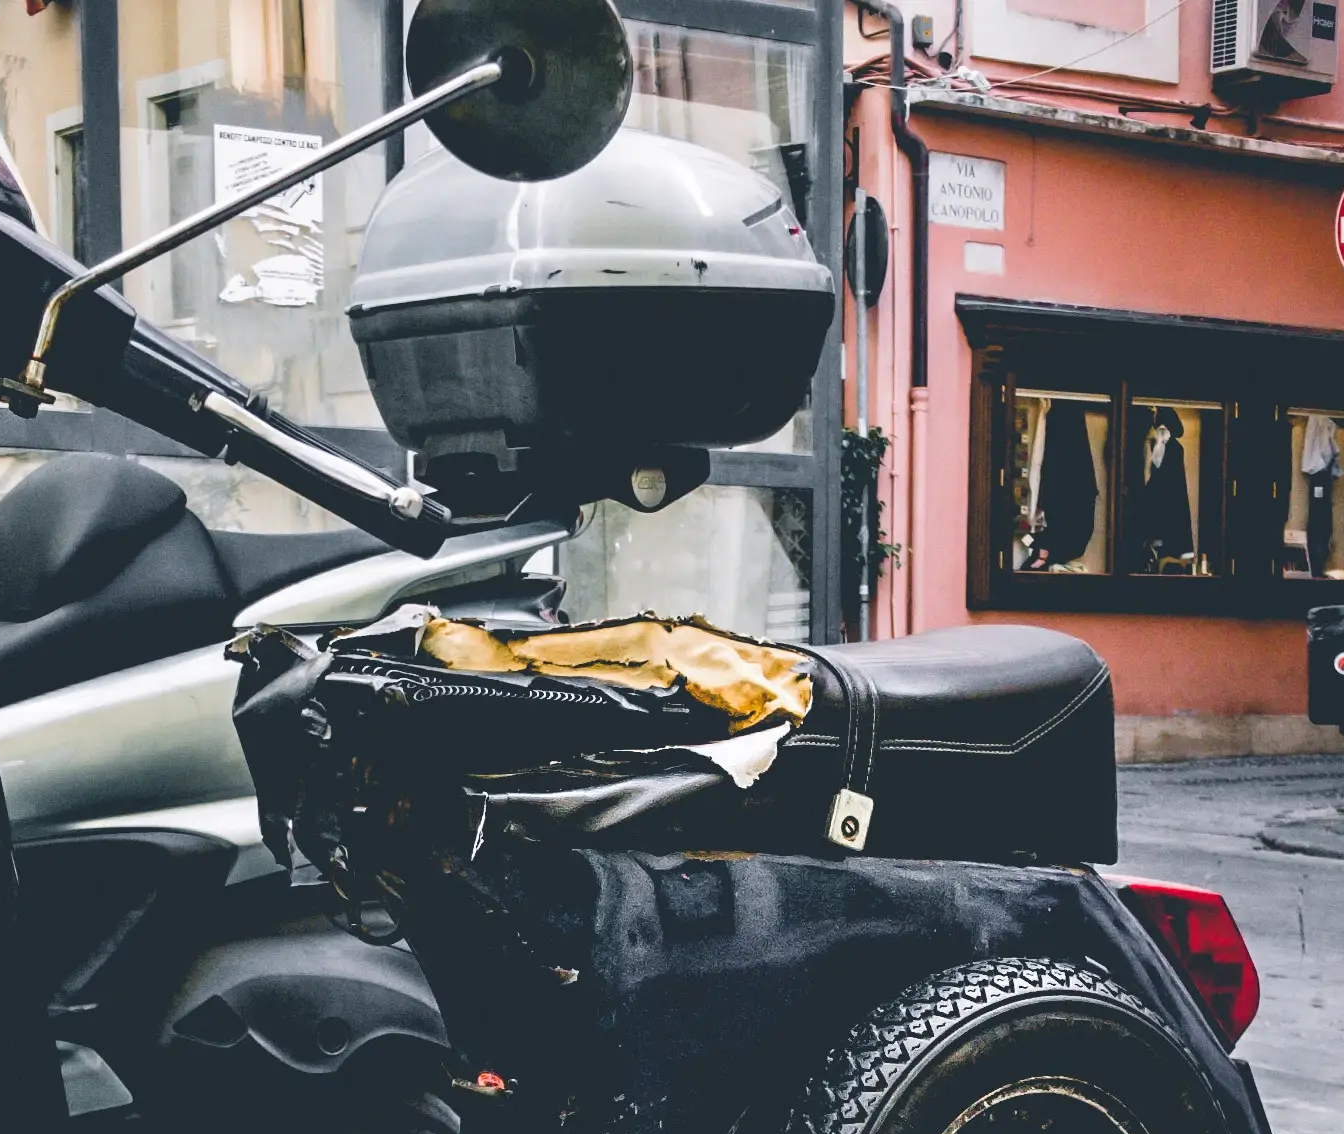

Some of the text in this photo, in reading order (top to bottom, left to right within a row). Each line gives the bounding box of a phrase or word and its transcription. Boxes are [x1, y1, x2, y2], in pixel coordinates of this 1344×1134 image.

[957, 163, 976, 178] VIA
[940, 182, 994, 201] ANTONIO
[931, 202, 999, 223] CANOPOLO
